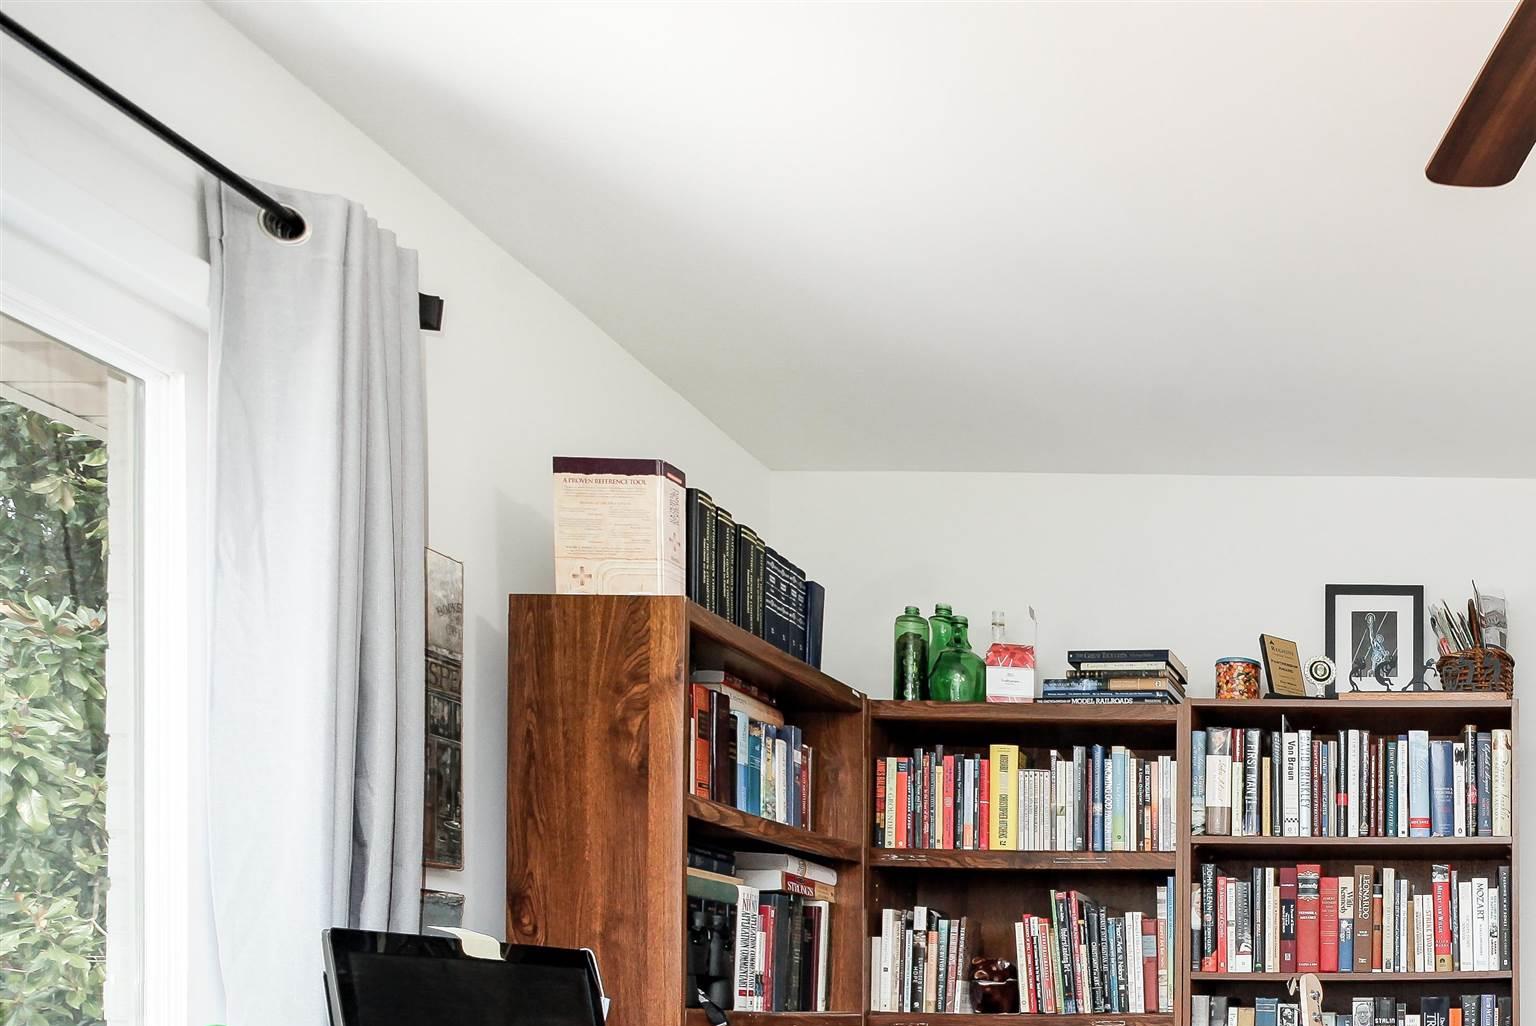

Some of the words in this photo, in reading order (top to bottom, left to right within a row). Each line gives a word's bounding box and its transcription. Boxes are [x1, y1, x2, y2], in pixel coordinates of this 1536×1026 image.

[1246, 744, 1257, 771] FIRST
[1287, 741, 1296, 755] Von
[1246, 773, 1257, 793] MAN
[1287, 757, 1296, 781] Braun
[1300, 765, 1311, 809] BRINKLEY
[886, 792, 895, 837] GROUNDED
[787, 880, 815, 896] STRONG'S
[1206, 866, 1214, 886] JOHN
[1339, 886, 1347, 914] Kennedy
[1346, 891, 1354, 908] With
[1362, 874, 1371, 920] LEONARDO
[1476, 883, 1485, 921] MOZART
[738, 911, 750, 946] APPLICATION
[738, 948, 750, 988] COMMENTARY
[749, 949, 757, 988] COMMENTARY
